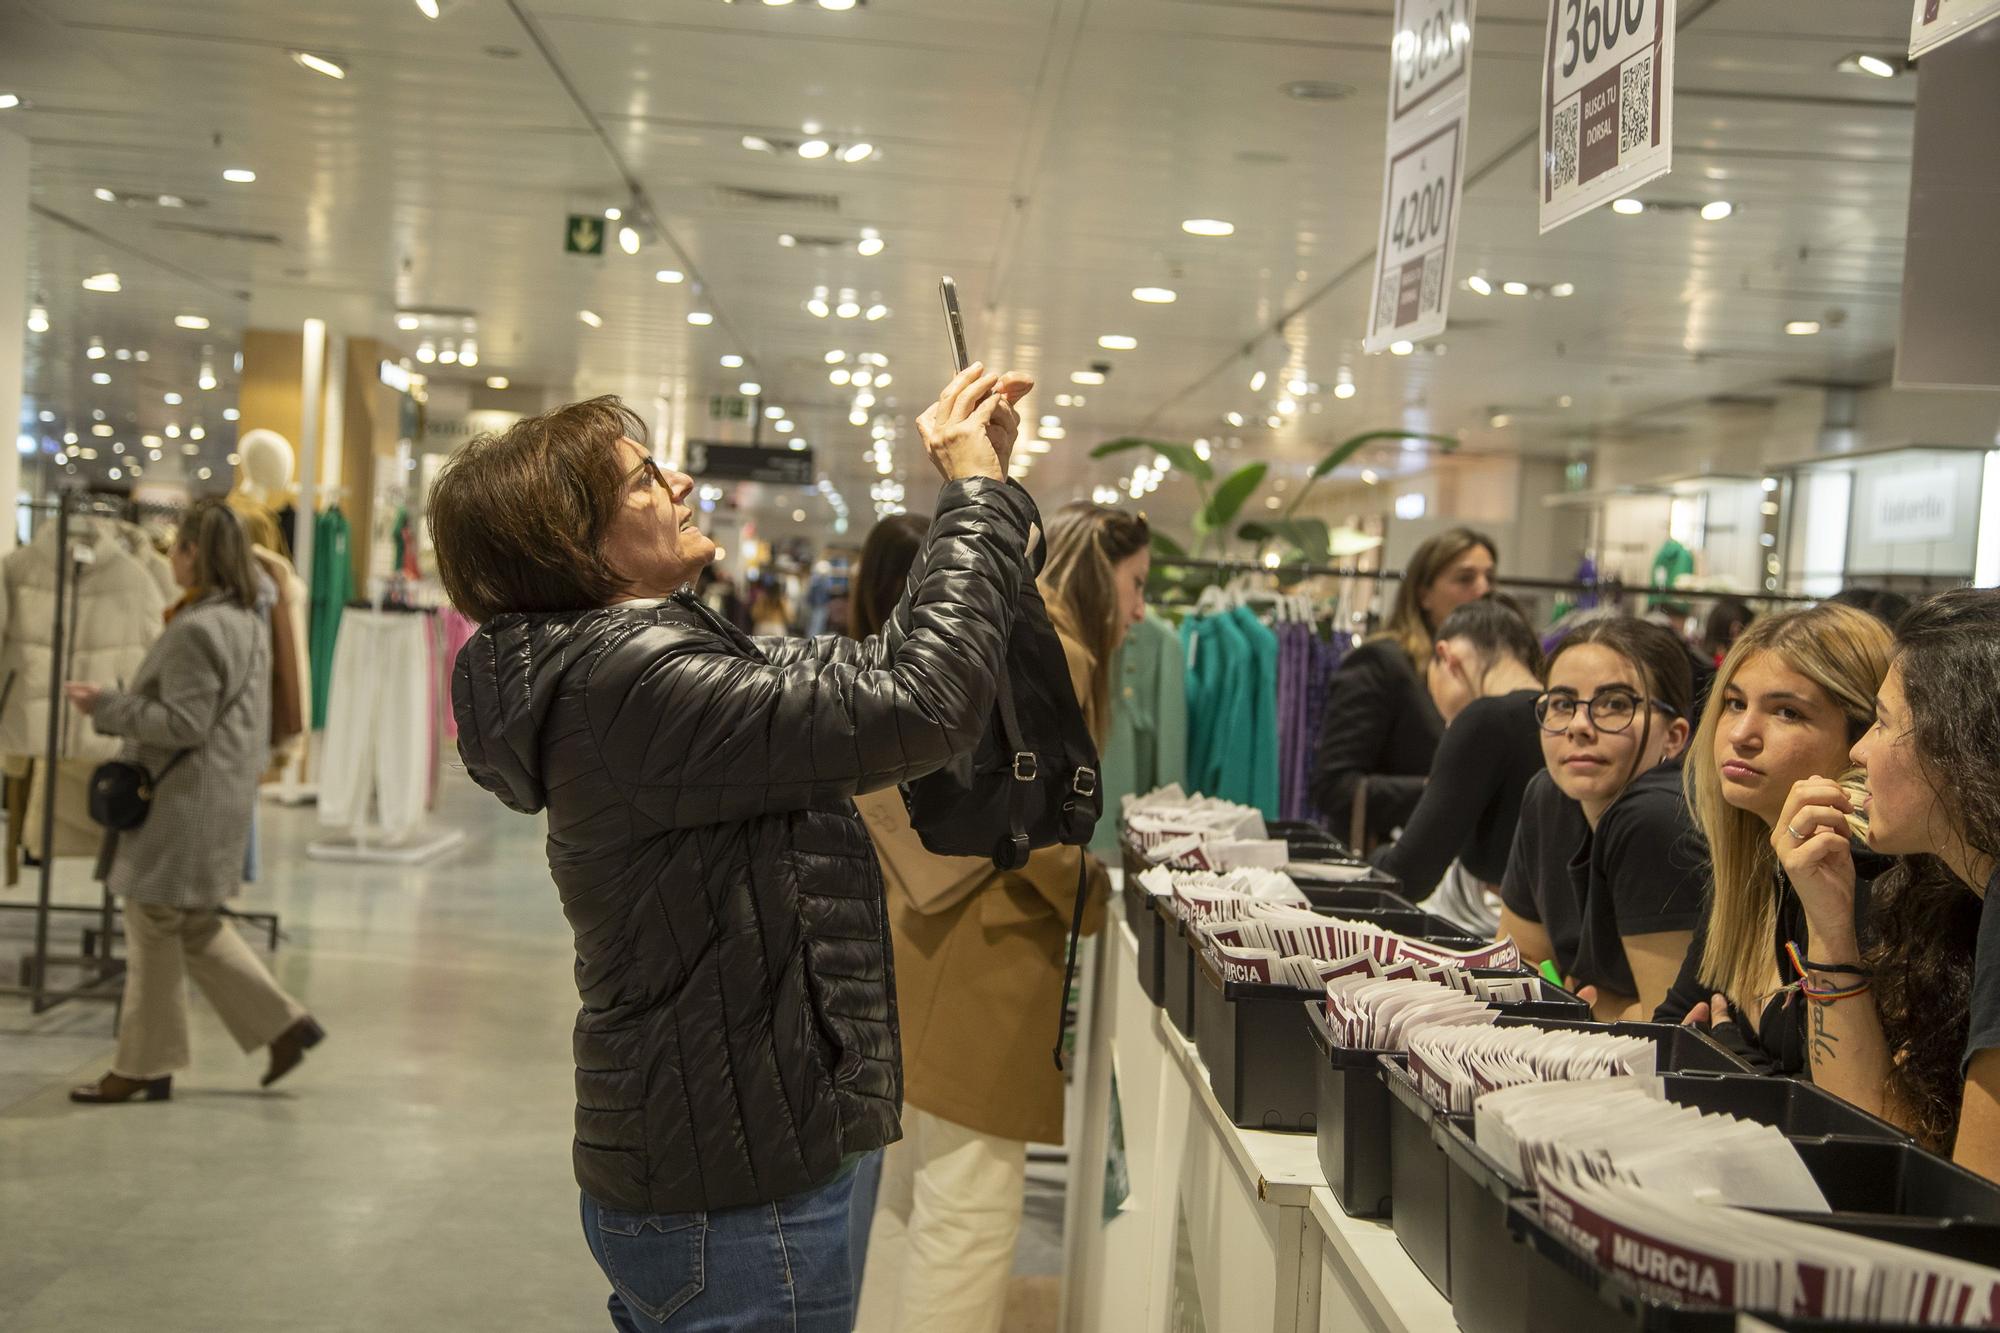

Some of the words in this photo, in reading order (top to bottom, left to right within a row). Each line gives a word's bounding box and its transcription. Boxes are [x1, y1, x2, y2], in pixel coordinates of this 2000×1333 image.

[1584, 93, 1606, 120] BUSCA
[1607, 84, 1617, 105] TU
[1586, 117, 1613, 147] DORSAL
[1392, 175, 1445, 251] 4200
[1611, 1232, 1722, 1301] MURCIA
